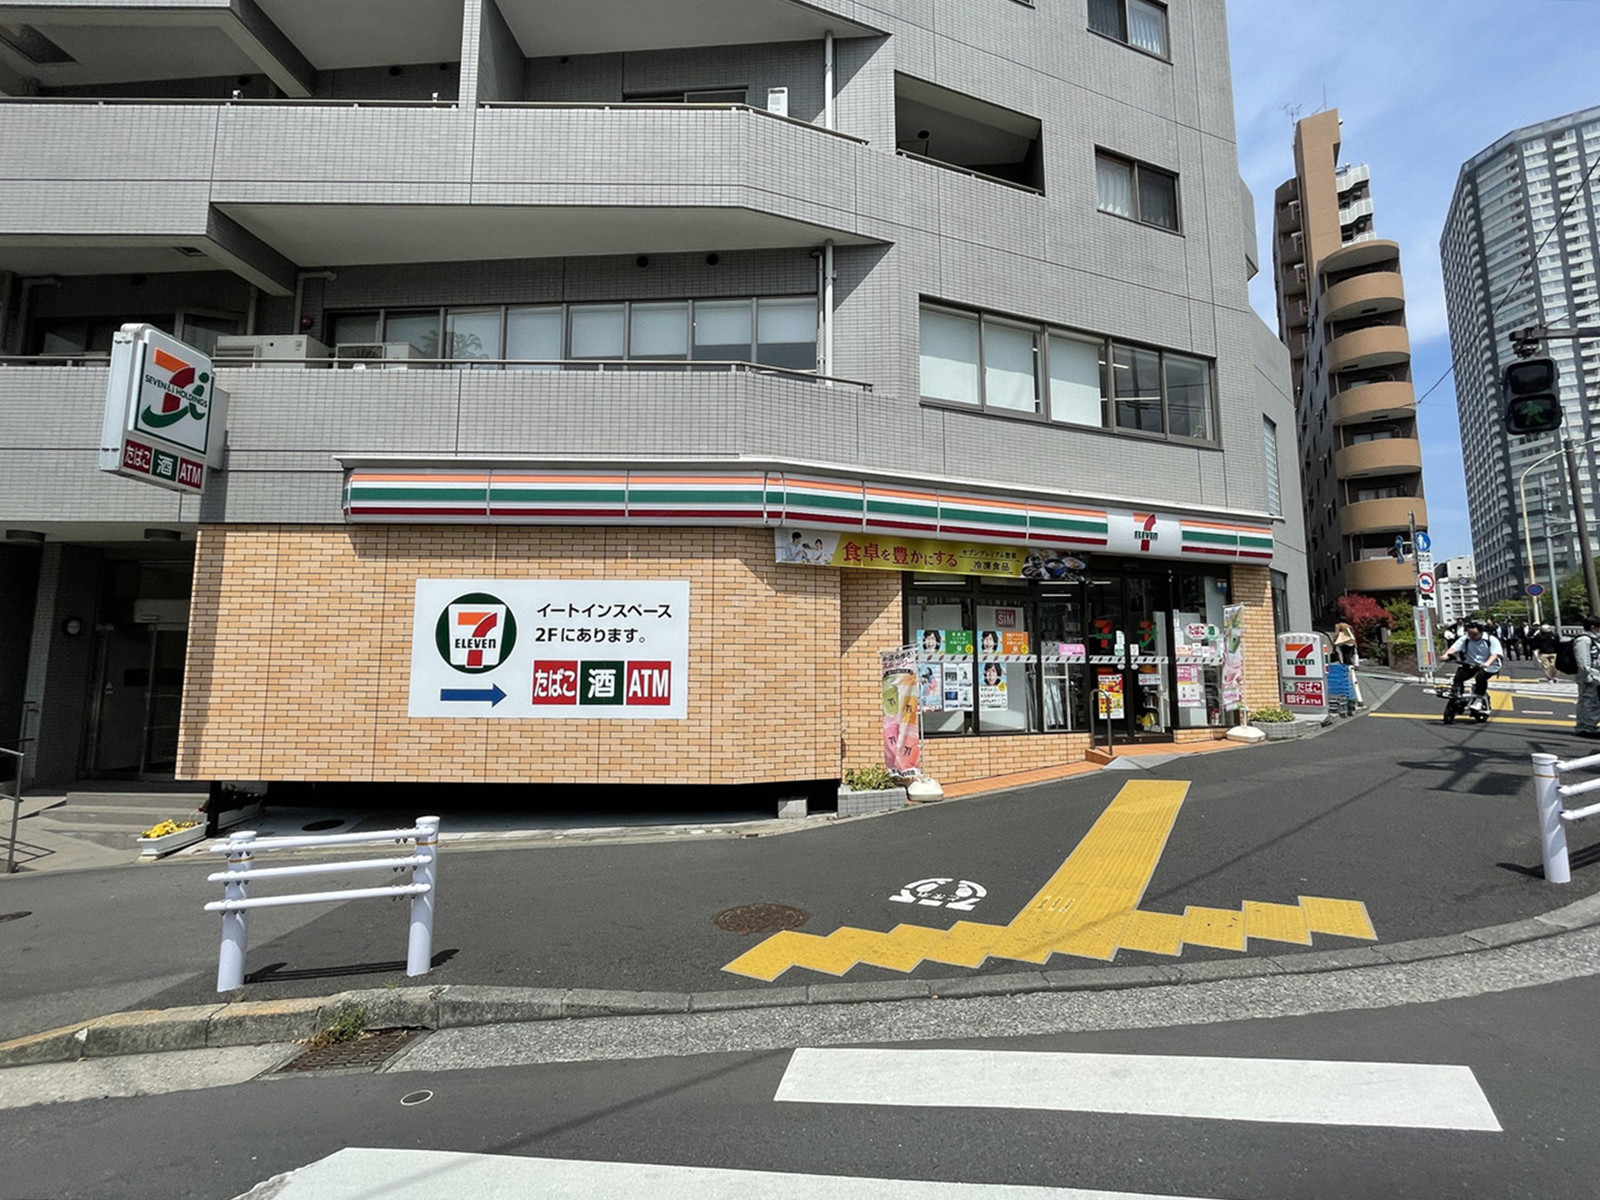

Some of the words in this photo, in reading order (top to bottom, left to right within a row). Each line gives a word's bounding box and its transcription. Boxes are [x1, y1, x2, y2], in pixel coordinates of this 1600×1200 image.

[176, 388, 208, 408] HOLDINGS
[125, 445, 150, 468] たばこ
[157, 454, 173, 476] 酒
[180, 463, 201, 485] ATM
[843, 541, 958, 568] 食卓を豊かにする
[536, 603, 673, 619] イートインスペース
[998, 614, 1015, 625] SIM
[535, 628, 646, 644] 2Fにあります。
[534, 668, 577, 698] たばこ
[588, 668, 616, 699] 酒
[628, 669, 670, 698] ATM
